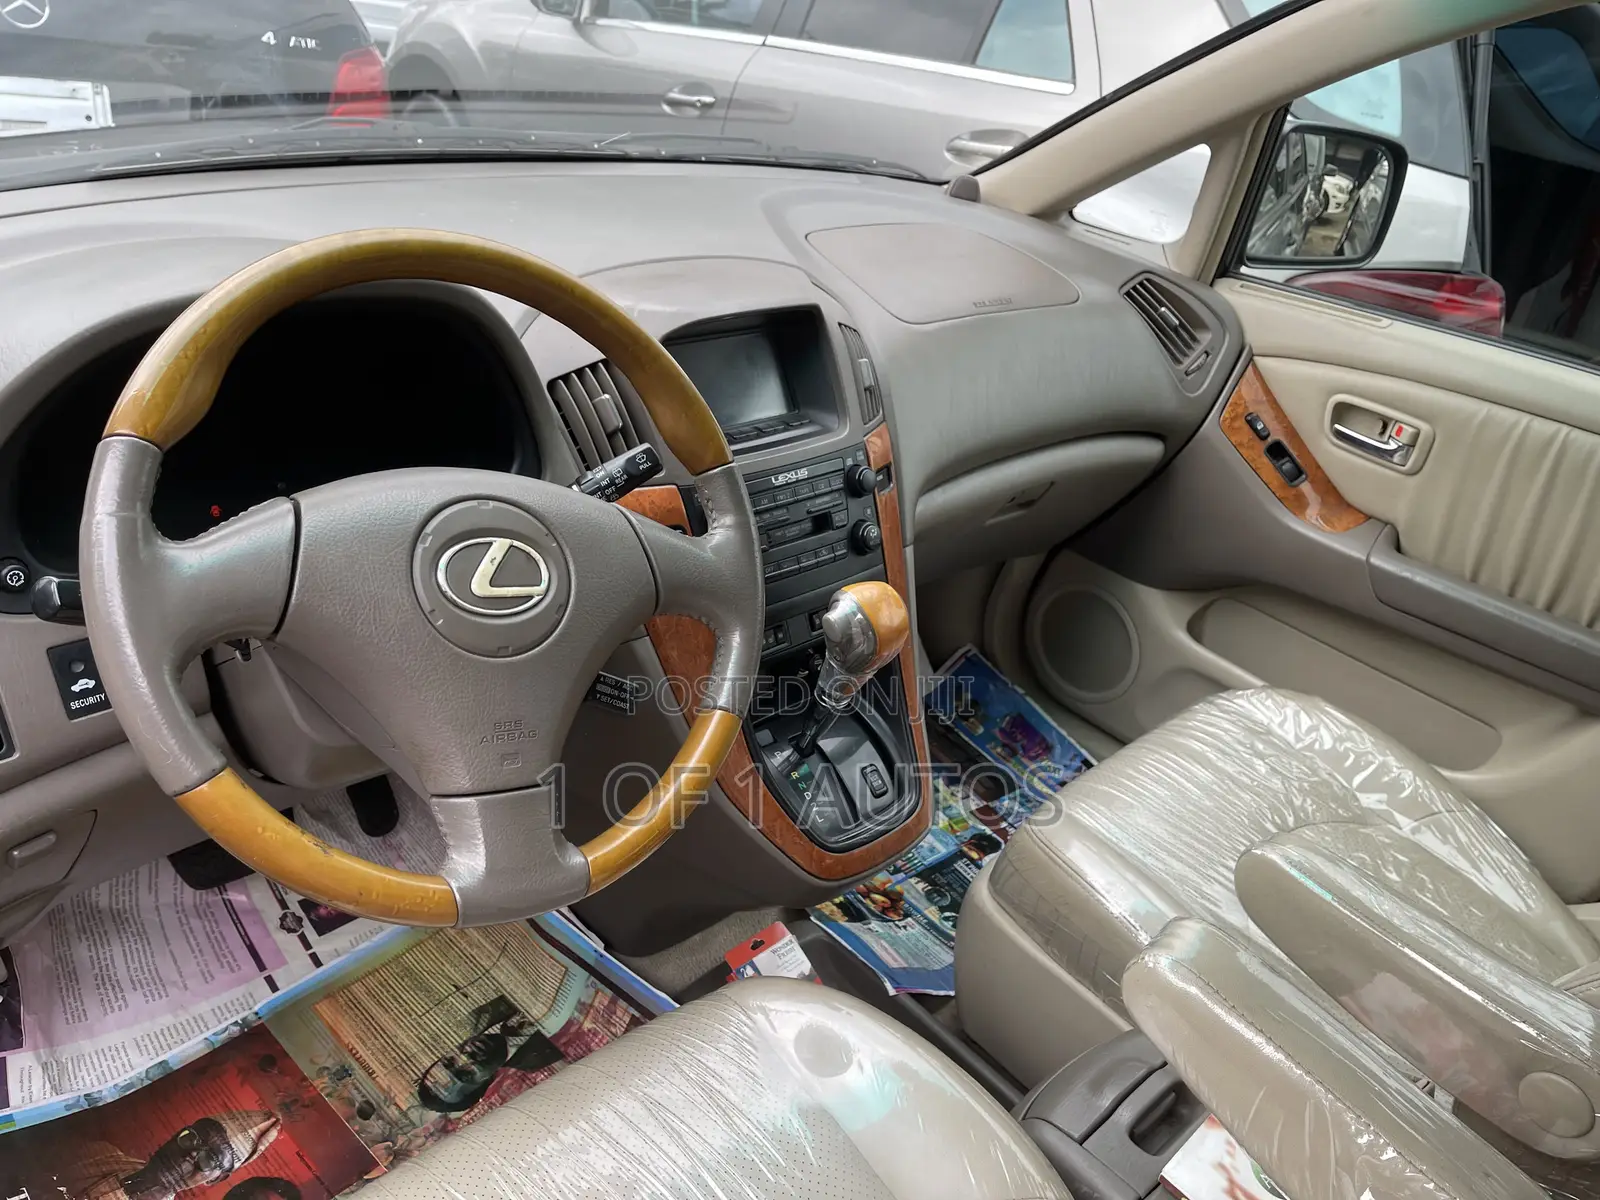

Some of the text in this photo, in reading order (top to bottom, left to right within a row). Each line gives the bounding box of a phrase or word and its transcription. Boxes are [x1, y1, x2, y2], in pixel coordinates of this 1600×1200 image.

[639, 462, 652, 471] PULL
[595, 471, 605, 479] ON
[615, 475, 628, 484] REAR
[771, 468, 808, 484] LEXUS
[600, 478, 611, 487] INT
[604, 486, 616, 495] OFF
[70, 693, 106, 709] SECURITY
[493, 720, 524, 732] SRS
[480, 730, 538, 745] AIRBAG
[774, 751, 782, 759] P
[790, 771, 800, 780] R
[798, 782, 807, 790] N
[804, 791, 812, 800] D
[811, 802, 819, 812] 2
[816, 815, 824, 823] L
